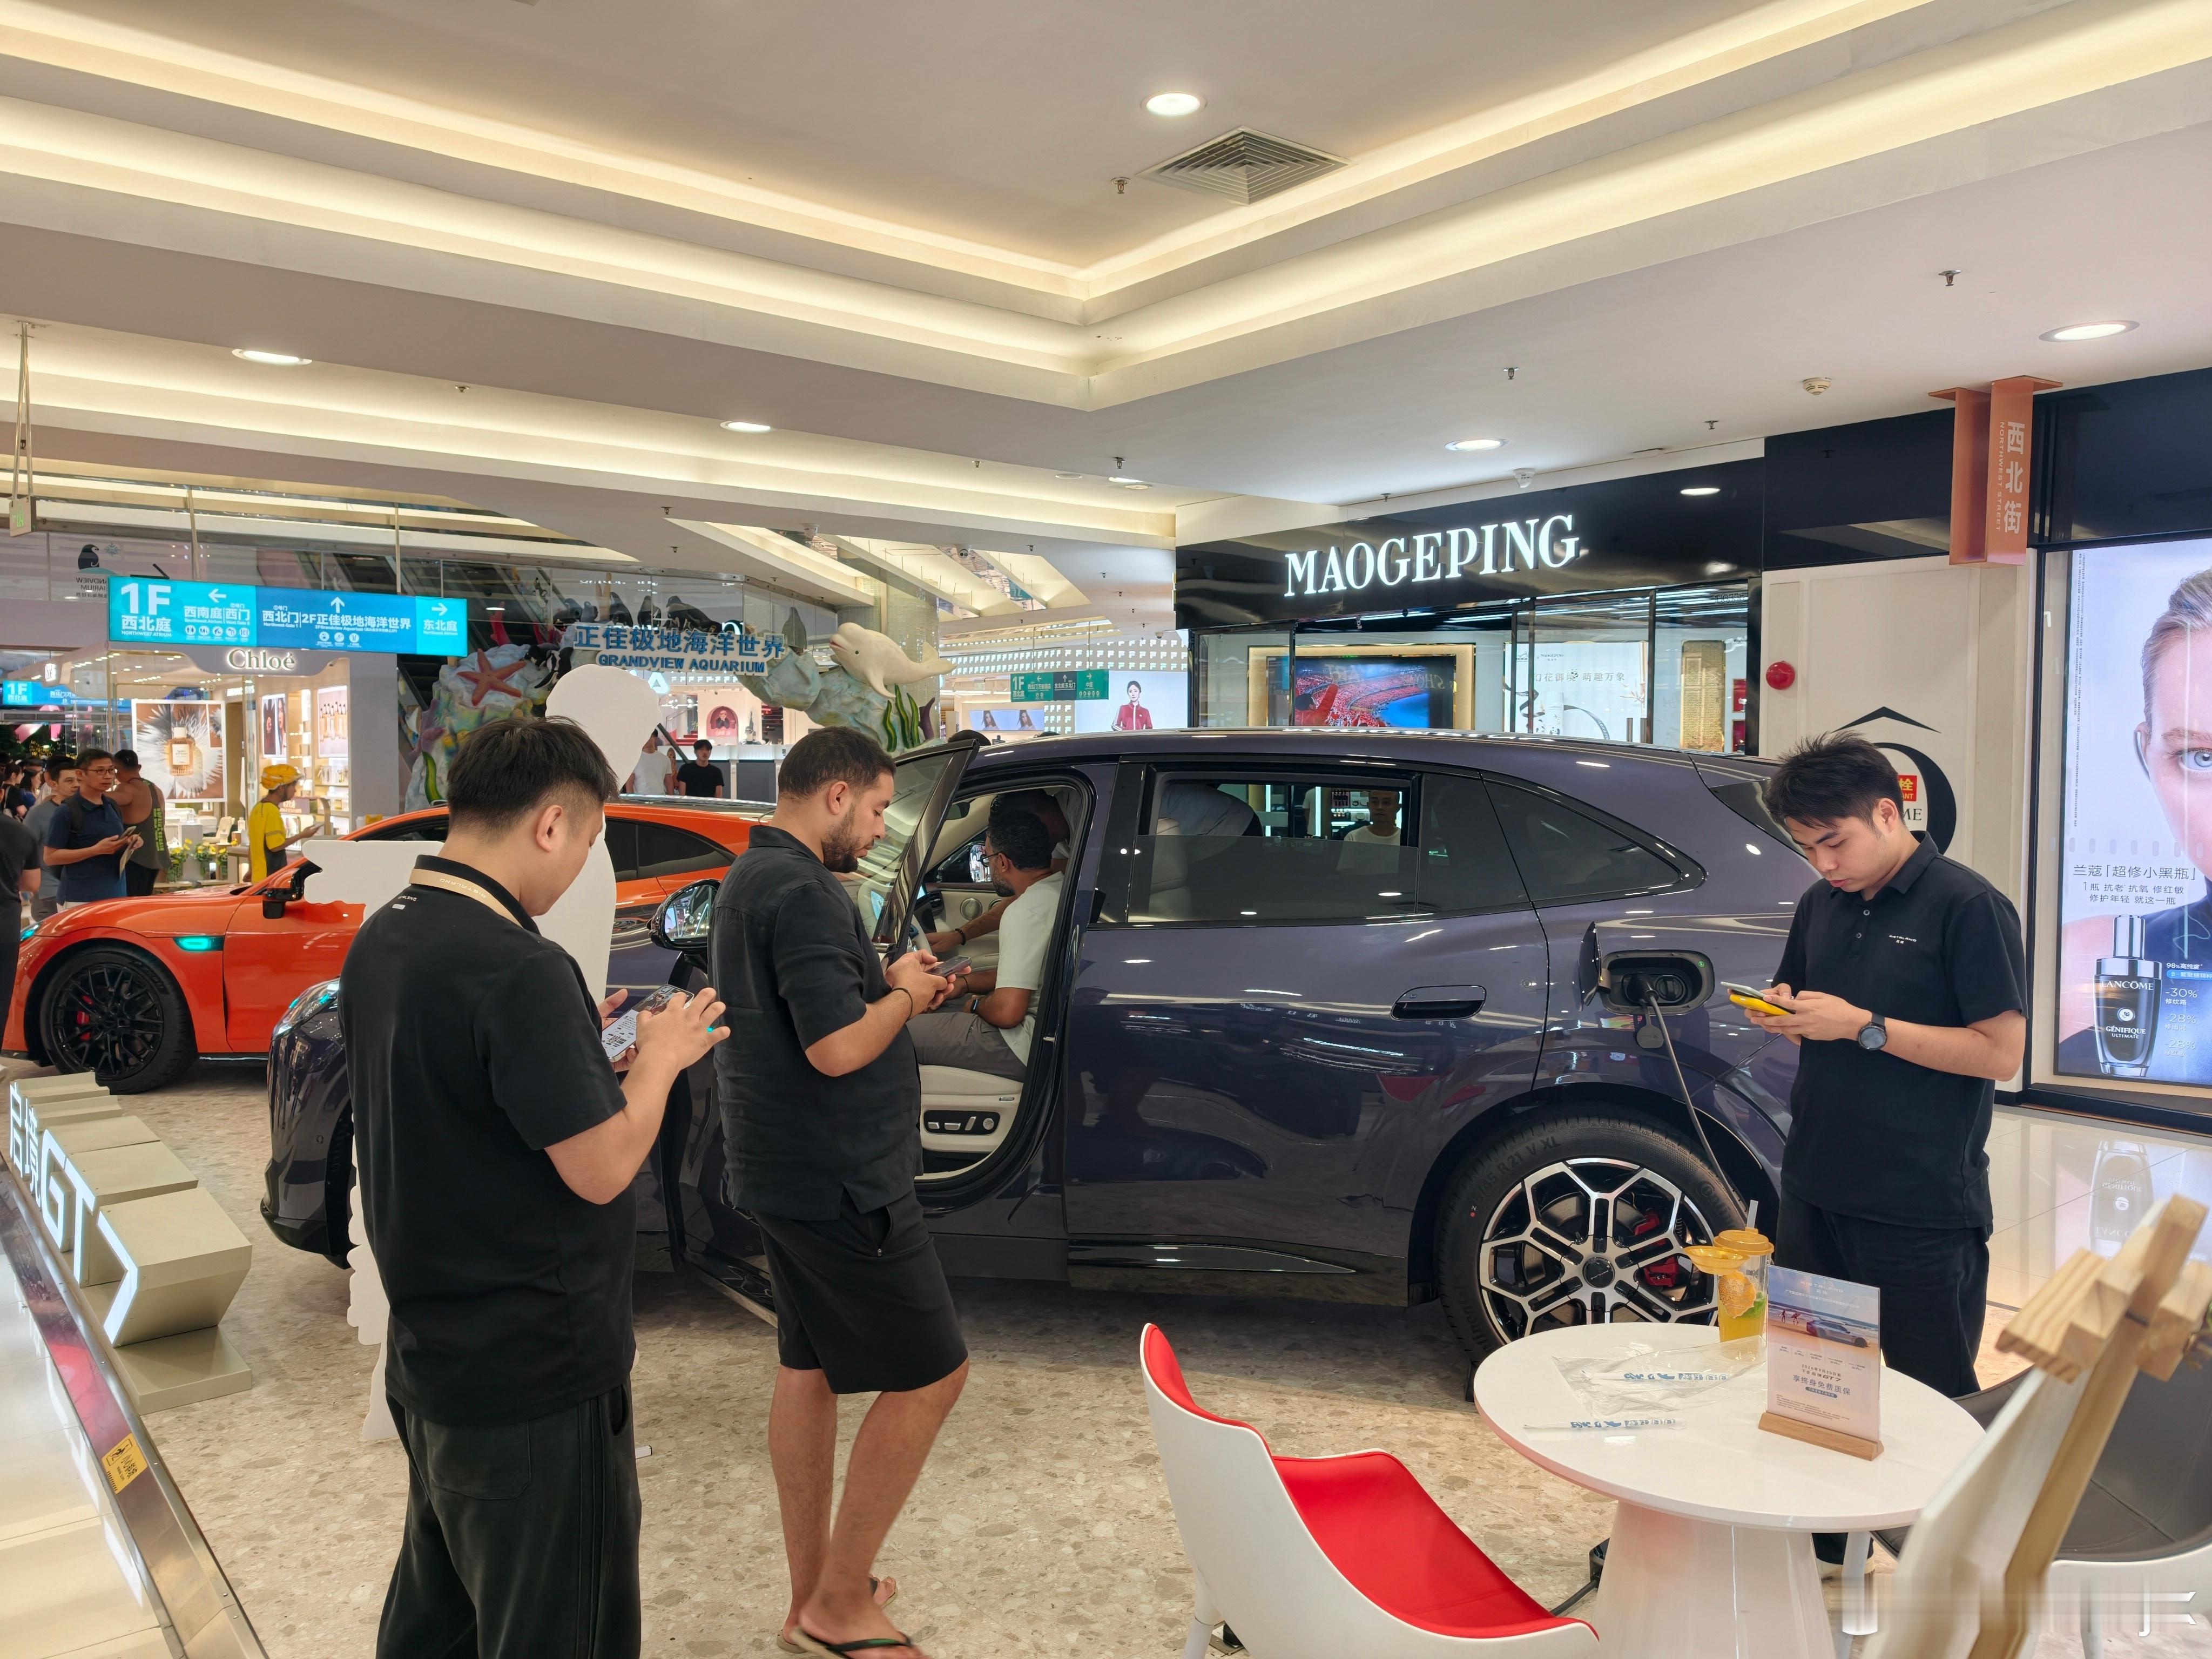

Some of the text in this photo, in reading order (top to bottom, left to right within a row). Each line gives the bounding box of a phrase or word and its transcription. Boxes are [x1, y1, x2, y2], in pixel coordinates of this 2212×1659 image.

[2004, 421, 2025, 534] 西北街
[1284, 514, 1580, 597] MAOGEPING
[121, 583, 171, 615] 1F
[184, 606, 250, 621] 西南庭 西门
[262, 610, 412, 630] 西北门 2F正佳极地海洋世界
[122, 615, 172, 632] 西北庭
[423, 619, 458, 632] 东北庭
[575, 625, 785, 658] 正佳极地海洋世界
[227, 649, 295, 670] Chloé
[599, 653, 765, 673] GRANDVIEW AQUARIUM
[7, 683, 26, 694] 1F
[1013, 676, 1024, 690] 1F
[2083, 882, 2100, 892] 1瓶
[2128, 885, 2148, 893] 抗氧
[2089, 894, 2176, 905] 修护年轻 就这一瓶
[2101, 980, 2154, 990] LANCÔME
[2165, 988, 2198, 998] -30%
[2164, 1014, 2197, 1024] -28%
[2106, 1025, 2147, 1035] GÉNIFIQUE
[2164, 1039, 2196, 1050] -28%
[1792, 1374, 1851, 1395] 享终身免费质保
